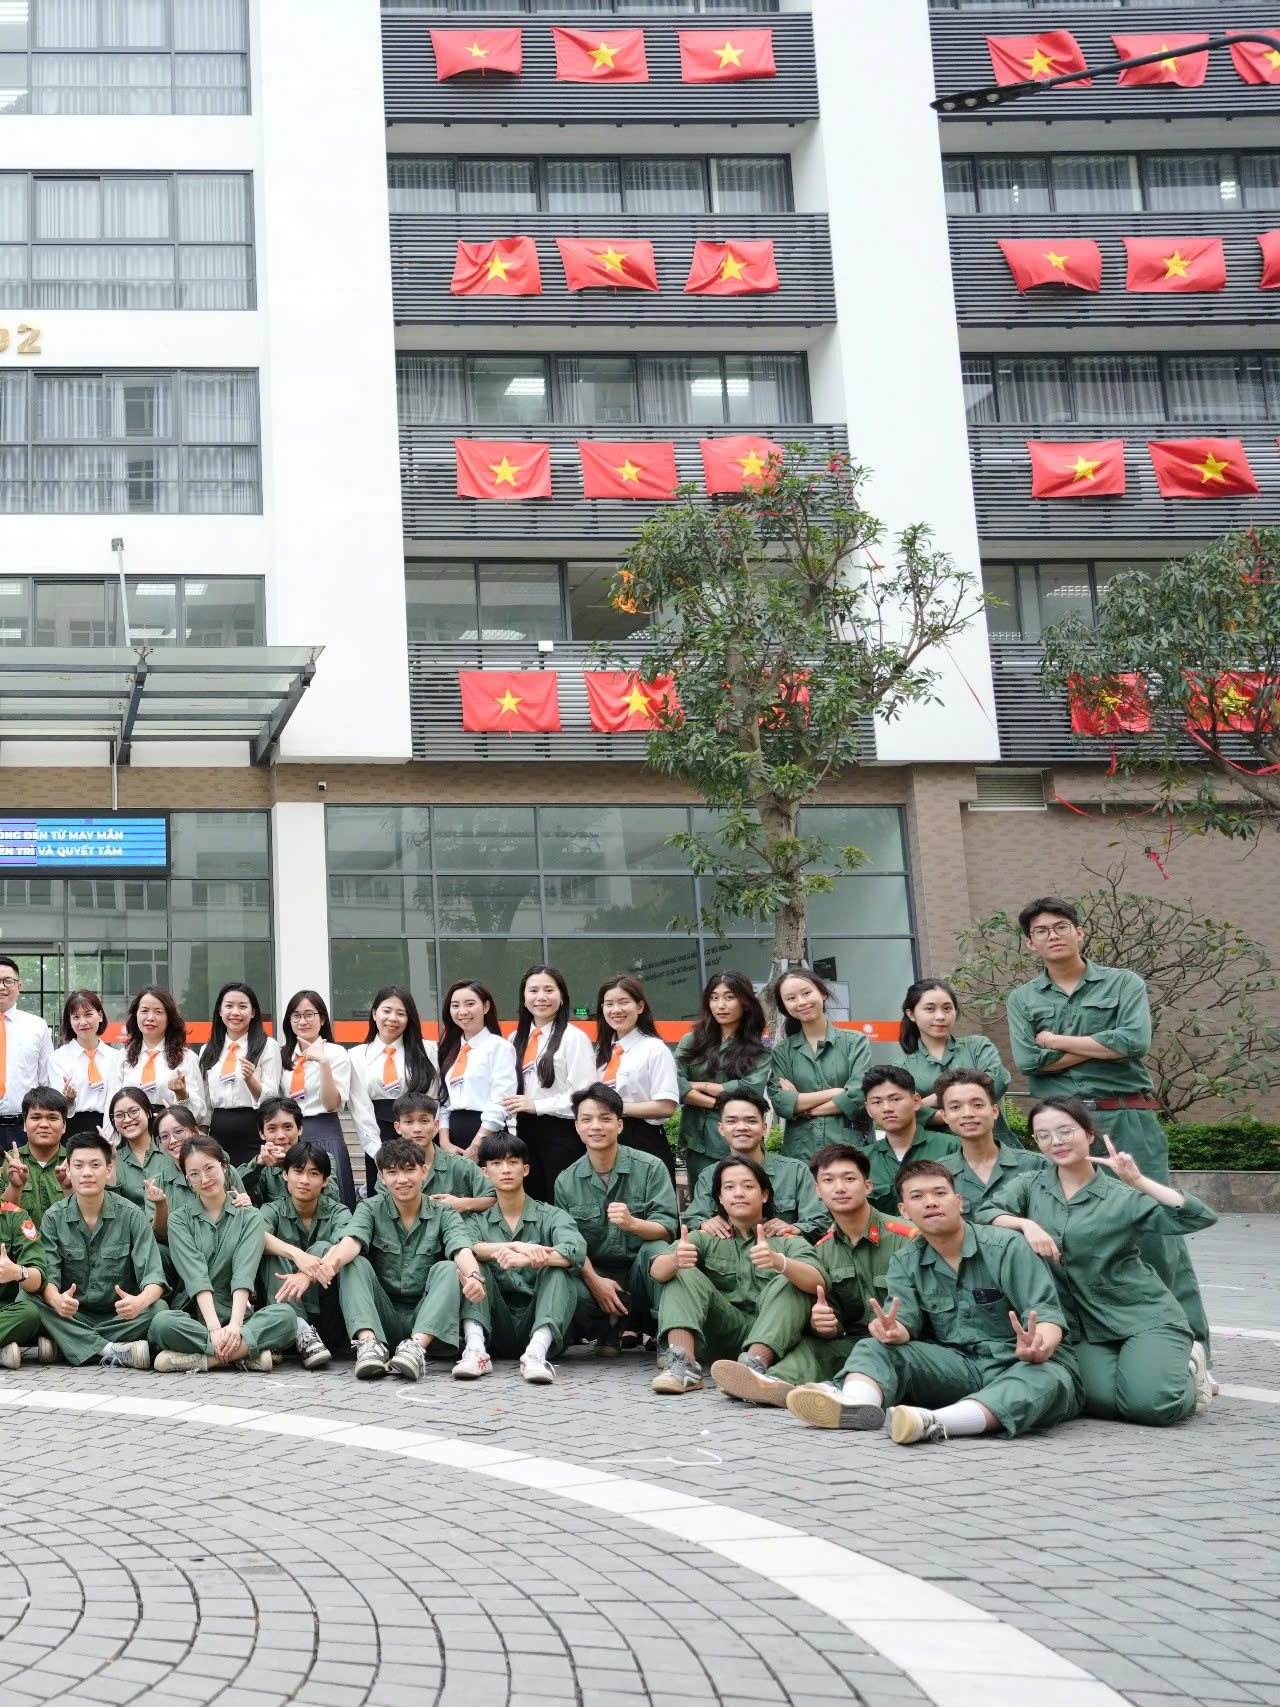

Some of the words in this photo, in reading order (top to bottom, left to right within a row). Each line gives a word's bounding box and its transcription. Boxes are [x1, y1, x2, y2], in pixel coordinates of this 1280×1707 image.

[23, 829, 48, 840] ĐẾN
[51, 829, 67, 840] TỪ
[69, 832, 94, 840] MAY
[16, 845, 36, 856] TRÌ
[38, 845, 55, 856] VÀ
[57, 845, 94, 857] QUYẾT
[97, 845, 123, 856] TÂM
